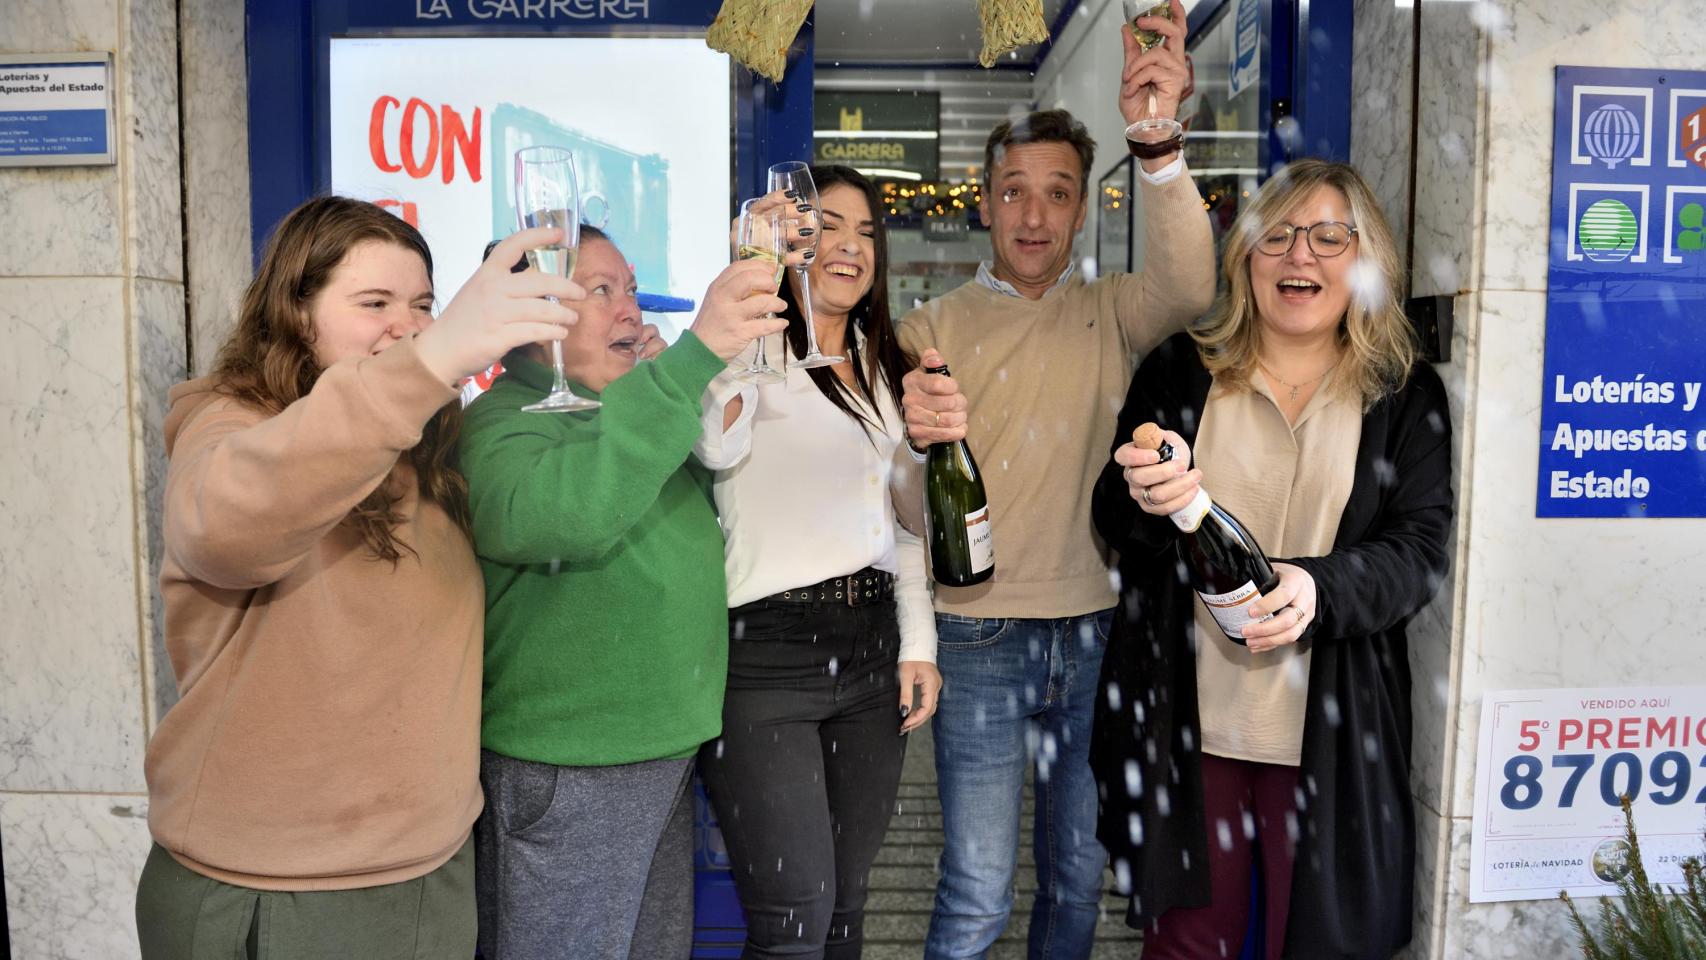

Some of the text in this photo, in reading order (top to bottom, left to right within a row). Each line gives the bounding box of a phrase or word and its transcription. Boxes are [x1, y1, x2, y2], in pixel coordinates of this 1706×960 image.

[416, 0, 452, 18] LA
[43, 73, 49, 82] y
[0, 83, 104, 94] Apuestas del Estado
[369, 95, 482, 184] CON
[821, 142, 905, 160] CARRERA
[1555, 373, 1702, 412] Loterías y
[1551, 423, 1687, 459] Apuestas
[1550, 469, 1650, 499] Estado
[1581, 696, 1671, 709] VENDIDO AQUÍ
[1500, 751, 1706, 810] 8709
[1542, 859, 1584, 868] NAVIDAD
